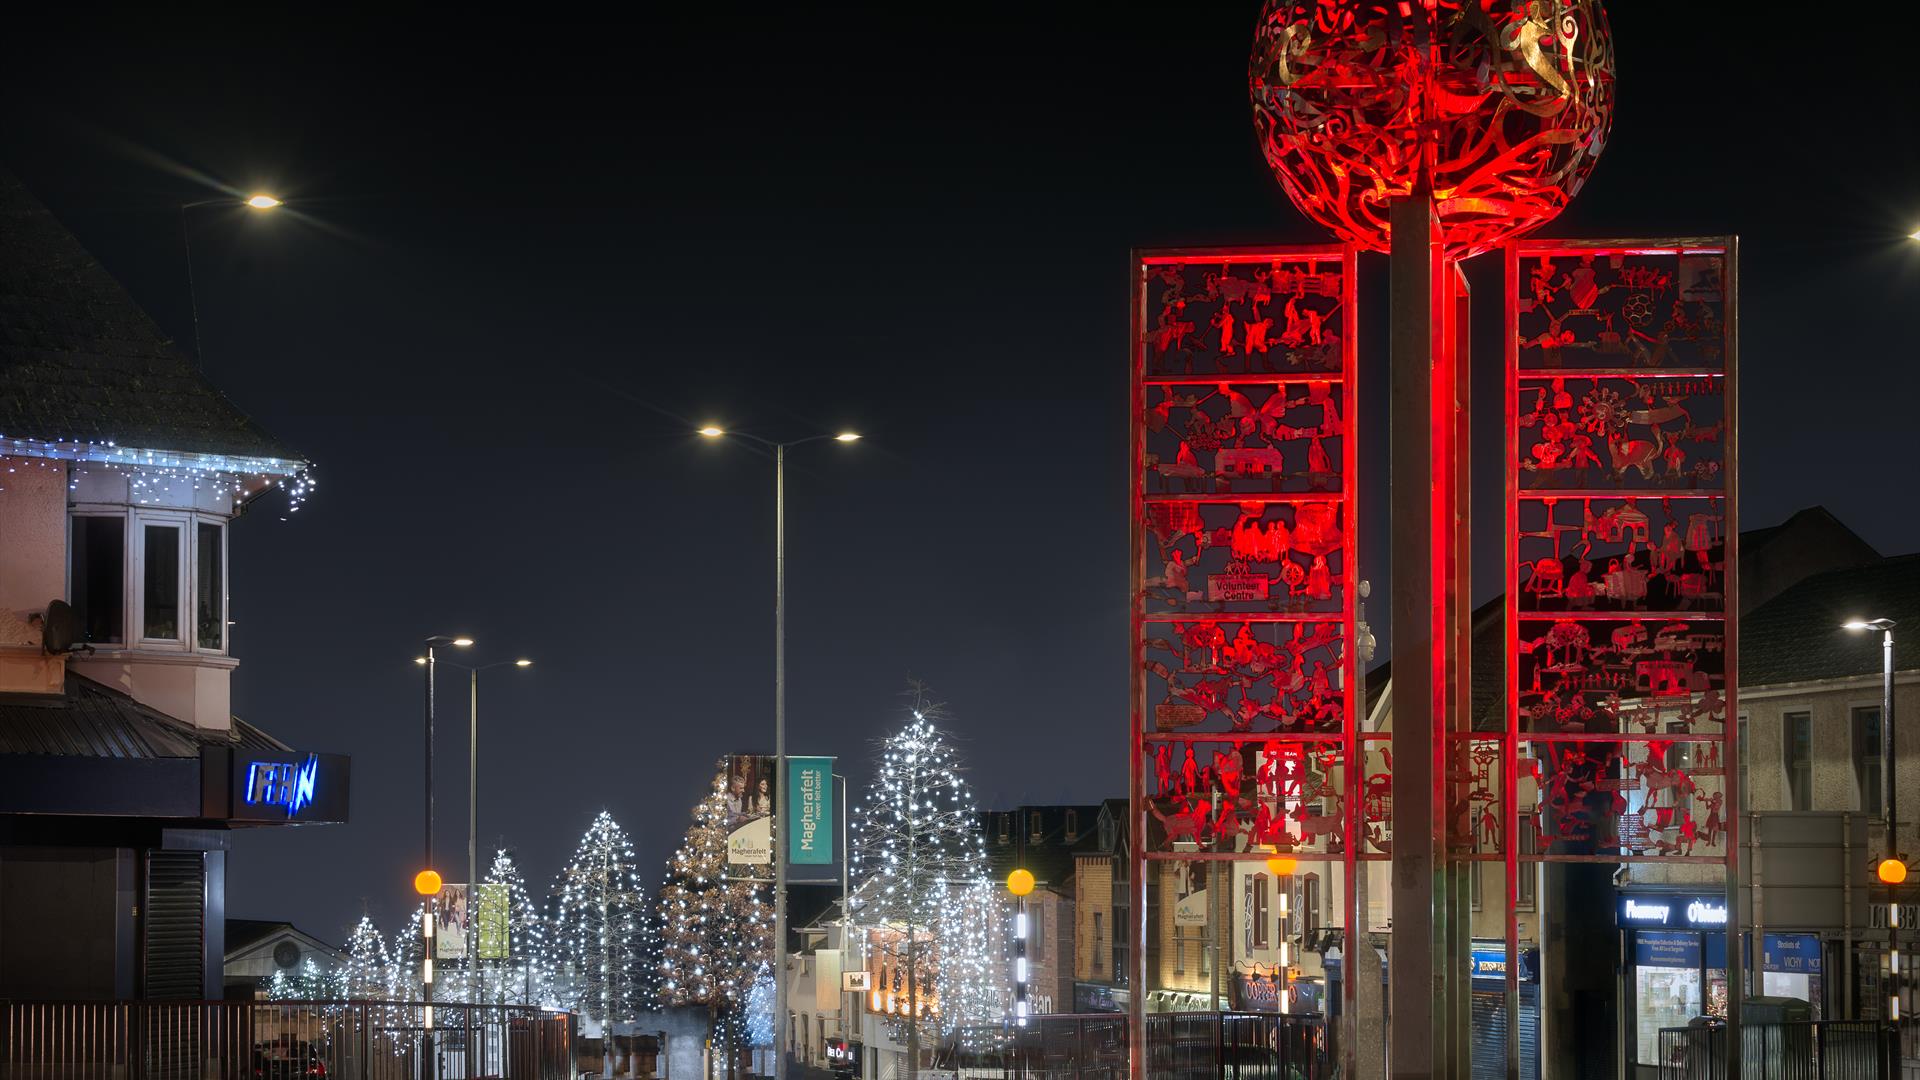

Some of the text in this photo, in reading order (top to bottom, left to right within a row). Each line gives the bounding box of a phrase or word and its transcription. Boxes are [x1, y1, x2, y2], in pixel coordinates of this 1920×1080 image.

[1216, 582, 1259, 591] Volunteer
[1224, 591, 1254, 600] Centre
[801, 769, 816, 850] Magherafelt
[731, 848, 767, 856] Magherafelt
[1626, 899, 1670, 924] Pharmacy
[1783, 956, 1802, 968] VICHY
[1246, 981, 1277, 1001] COPPER
